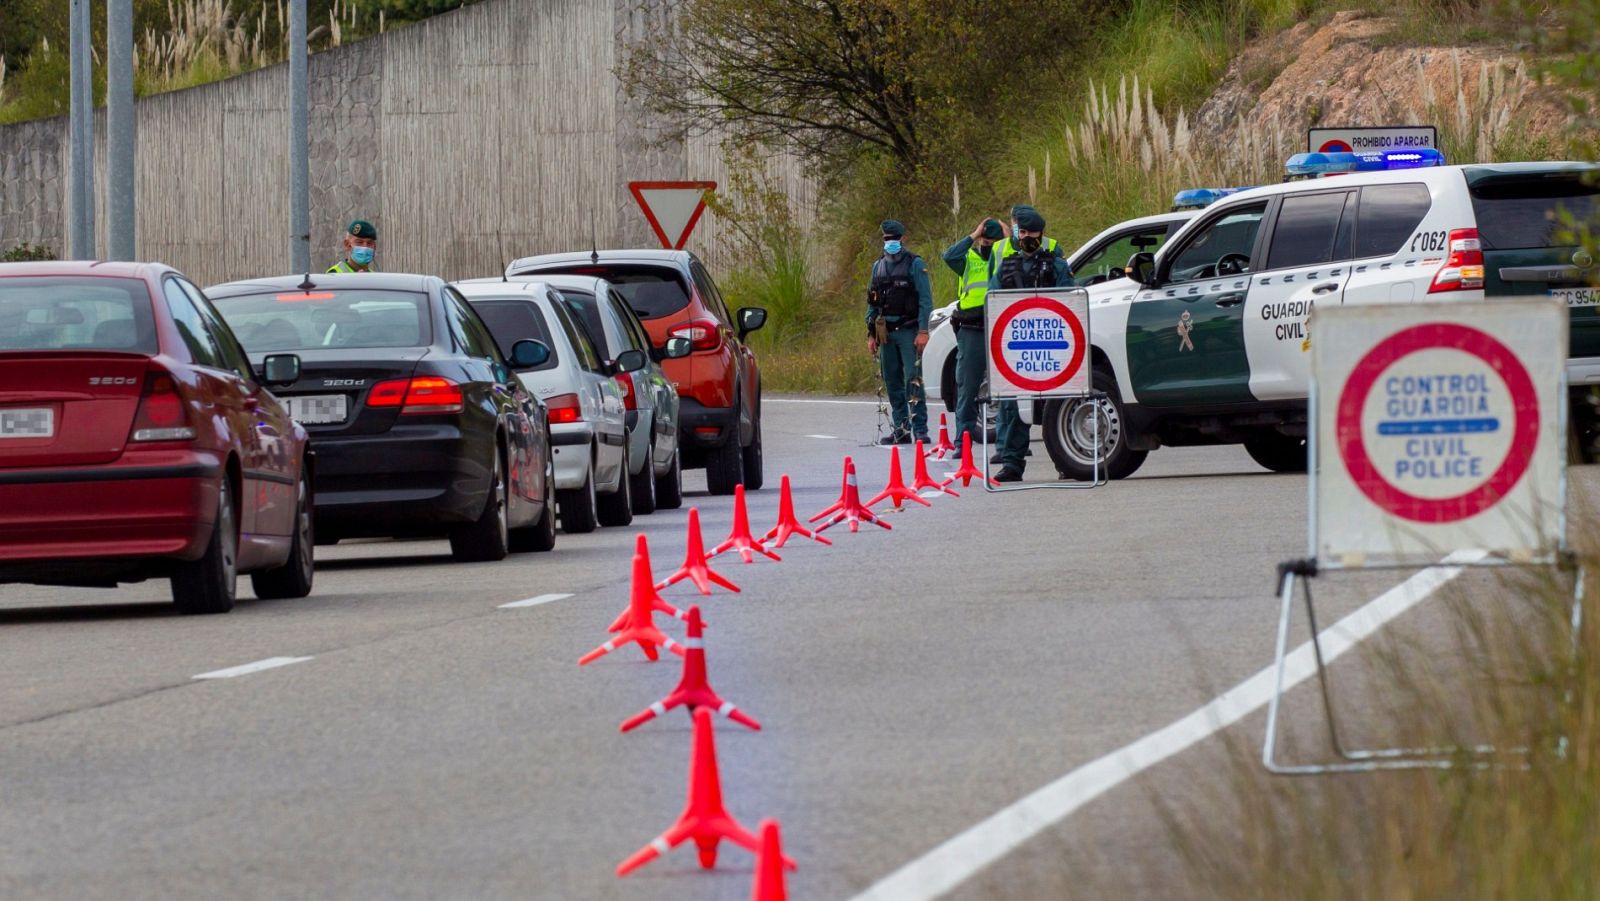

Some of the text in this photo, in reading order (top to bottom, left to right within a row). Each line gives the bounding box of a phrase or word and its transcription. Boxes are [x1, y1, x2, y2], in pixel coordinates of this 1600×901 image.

[1352, 135, 1429, 147] PROHIBIDO APARCAR
[1421, 231, 1447, 251] 062
[1011, 318, 1066, 329] CONTROL
[1275, 321, 1304, 340] CIVIL
[1011, 329, 1064, 340] GUARDIA
[1021, 351, 1055, 361] CIVIL
[1016, 361, 1061, 372] POLICE
[89, 377, 137, 385] 320d
[1386, 374, 1490, 396] CONTROL
[1386, 396, 1489, 417] GUARDIA
[1406, 438, 1470, 457] CIVIL
[1395, 457, 1483, 479] POLICE
